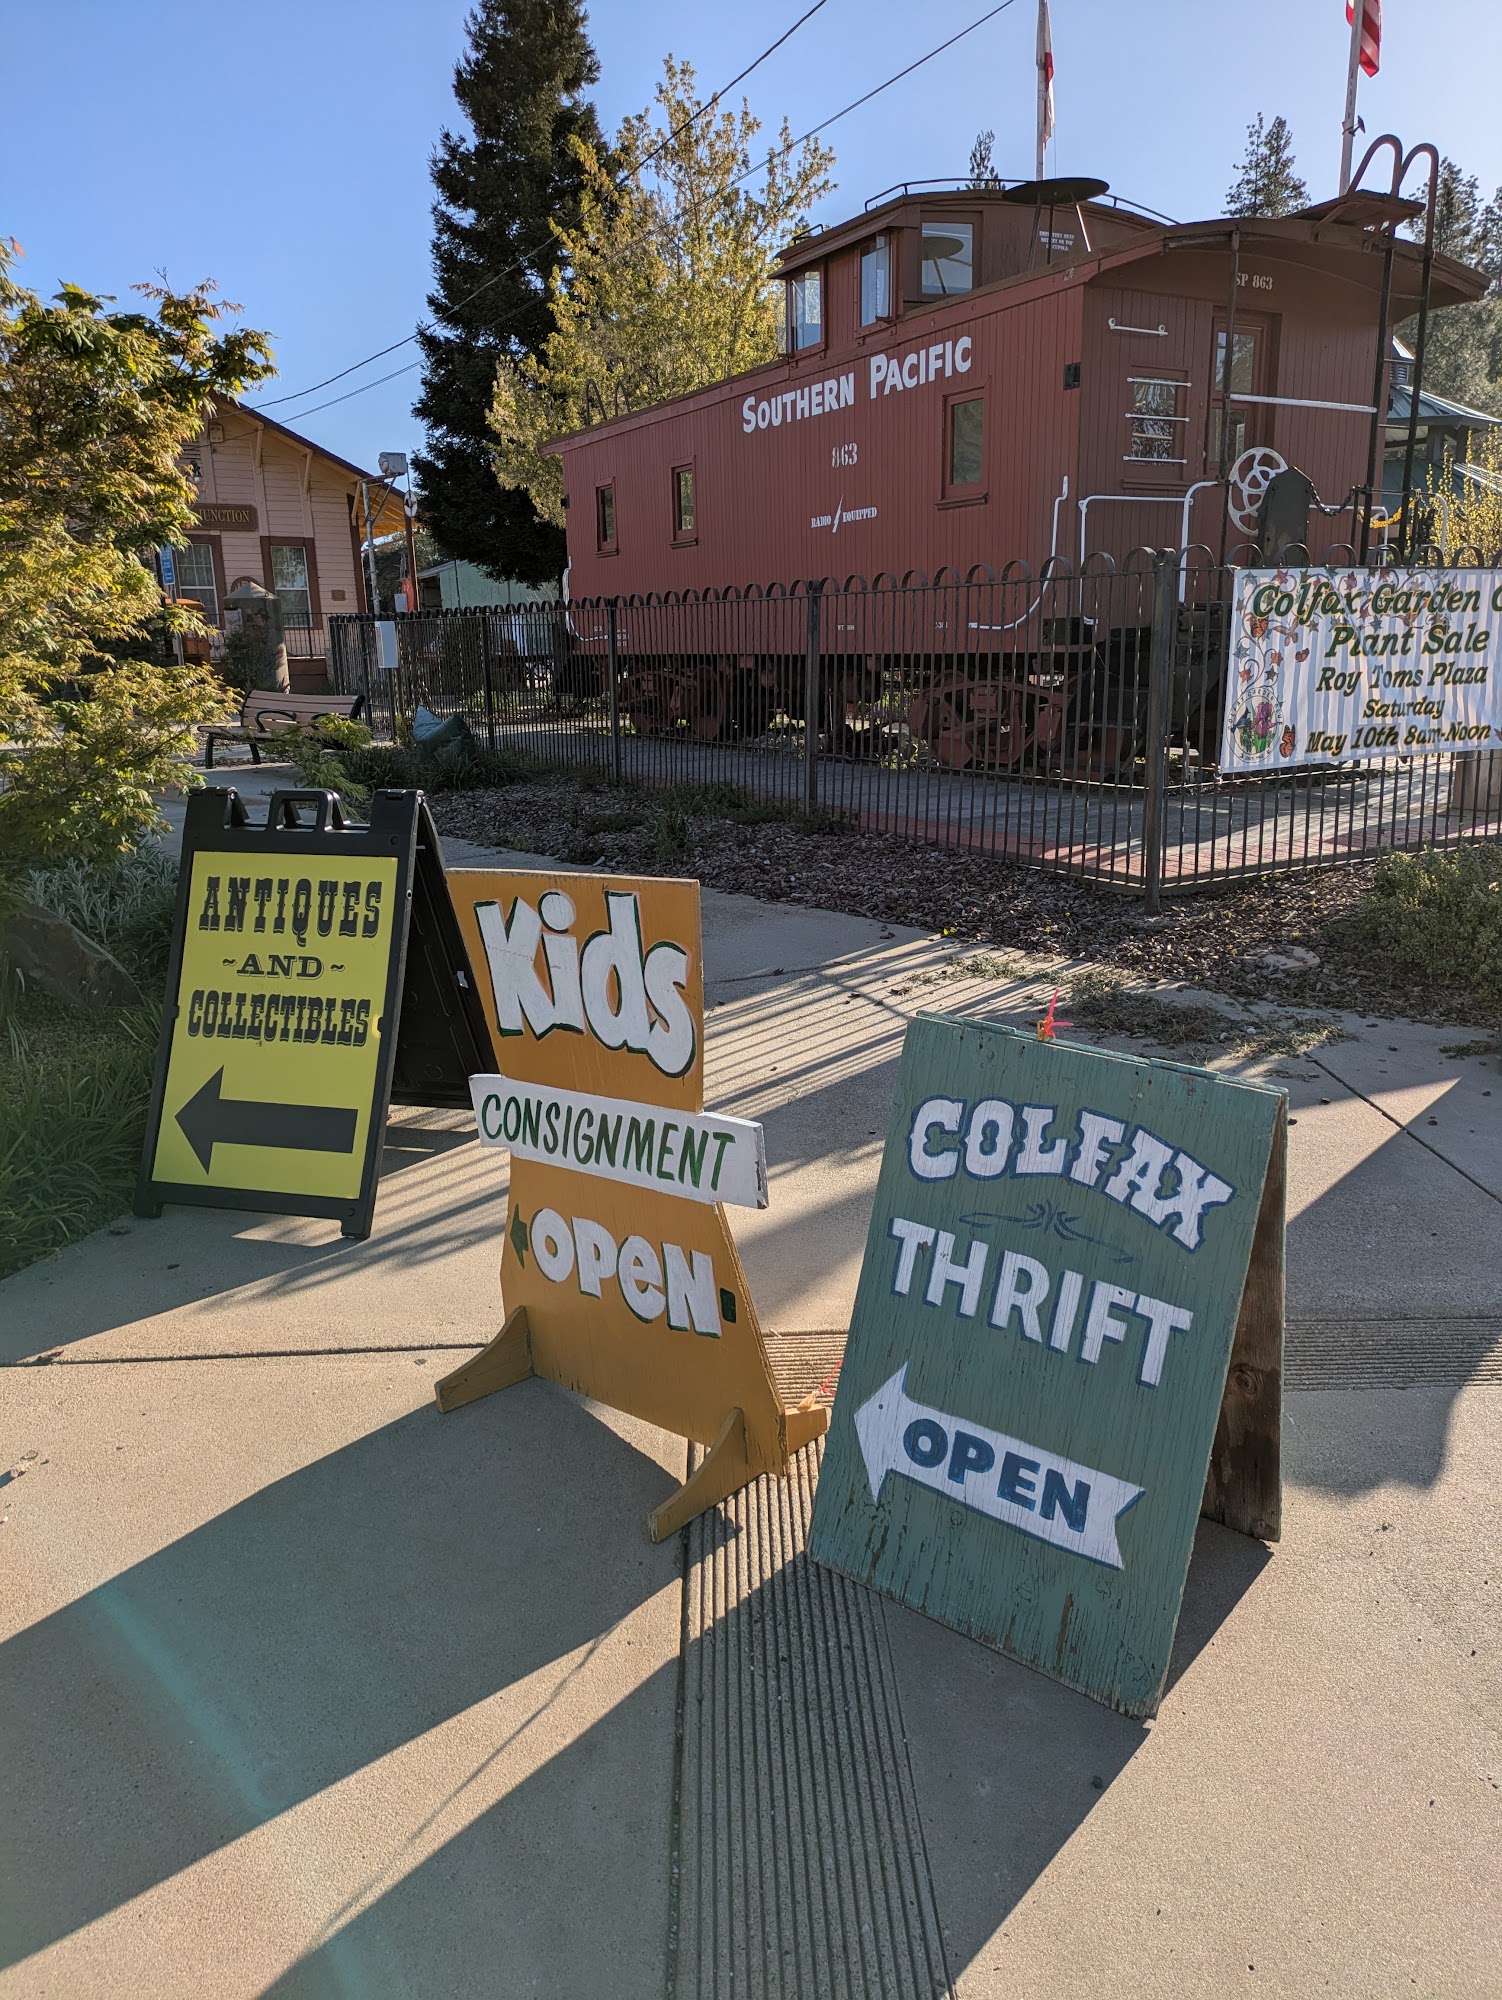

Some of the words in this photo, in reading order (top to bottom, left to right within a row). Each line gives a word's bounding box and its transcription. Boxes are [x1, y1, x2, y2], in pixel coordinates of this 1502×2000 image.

[1252, 274, 1273, 290] 863
[742, 372, 855, 434] SOUTHERN
[870, 336, 972, 400] PACIFIC
[831, 442, 858, 468] 863
[199, 508, 250, 523] JUNCTION
[811, 515, 832, 528] RADIO
[842, 506, 878, 523] EQUIPPED
[1252, 580, 1364, 625] Colfax
[1371, 578, 1480, 615] Garden
[1324, 624, 1415, 658] Plant
[1421, 621, 1491, 655] Sale
[1316, 666, 1362, 697] Roy
[1369, 664, 1424, 690] Toms
[1426, 661, 1489, 687] Plaza
[1362, 696, 1446, 720] Saturday
[1305, 731, 1349, 757] May
[1350, 724, 1399, 749] 10th
[198, 876, 383, 948] ANTIQUES
[473, 890, 697, 1079] Kids
[187, 989, 372, 1048] COLLECTIBLES
[481, 1093, 736, 1193] CONSIGNMENT
[906, 1095, 1237, 1254] COLFAX
[889, 1216, 1195, 1389] THRIFT
[903, 1418, 1091, 1534] OPEN
